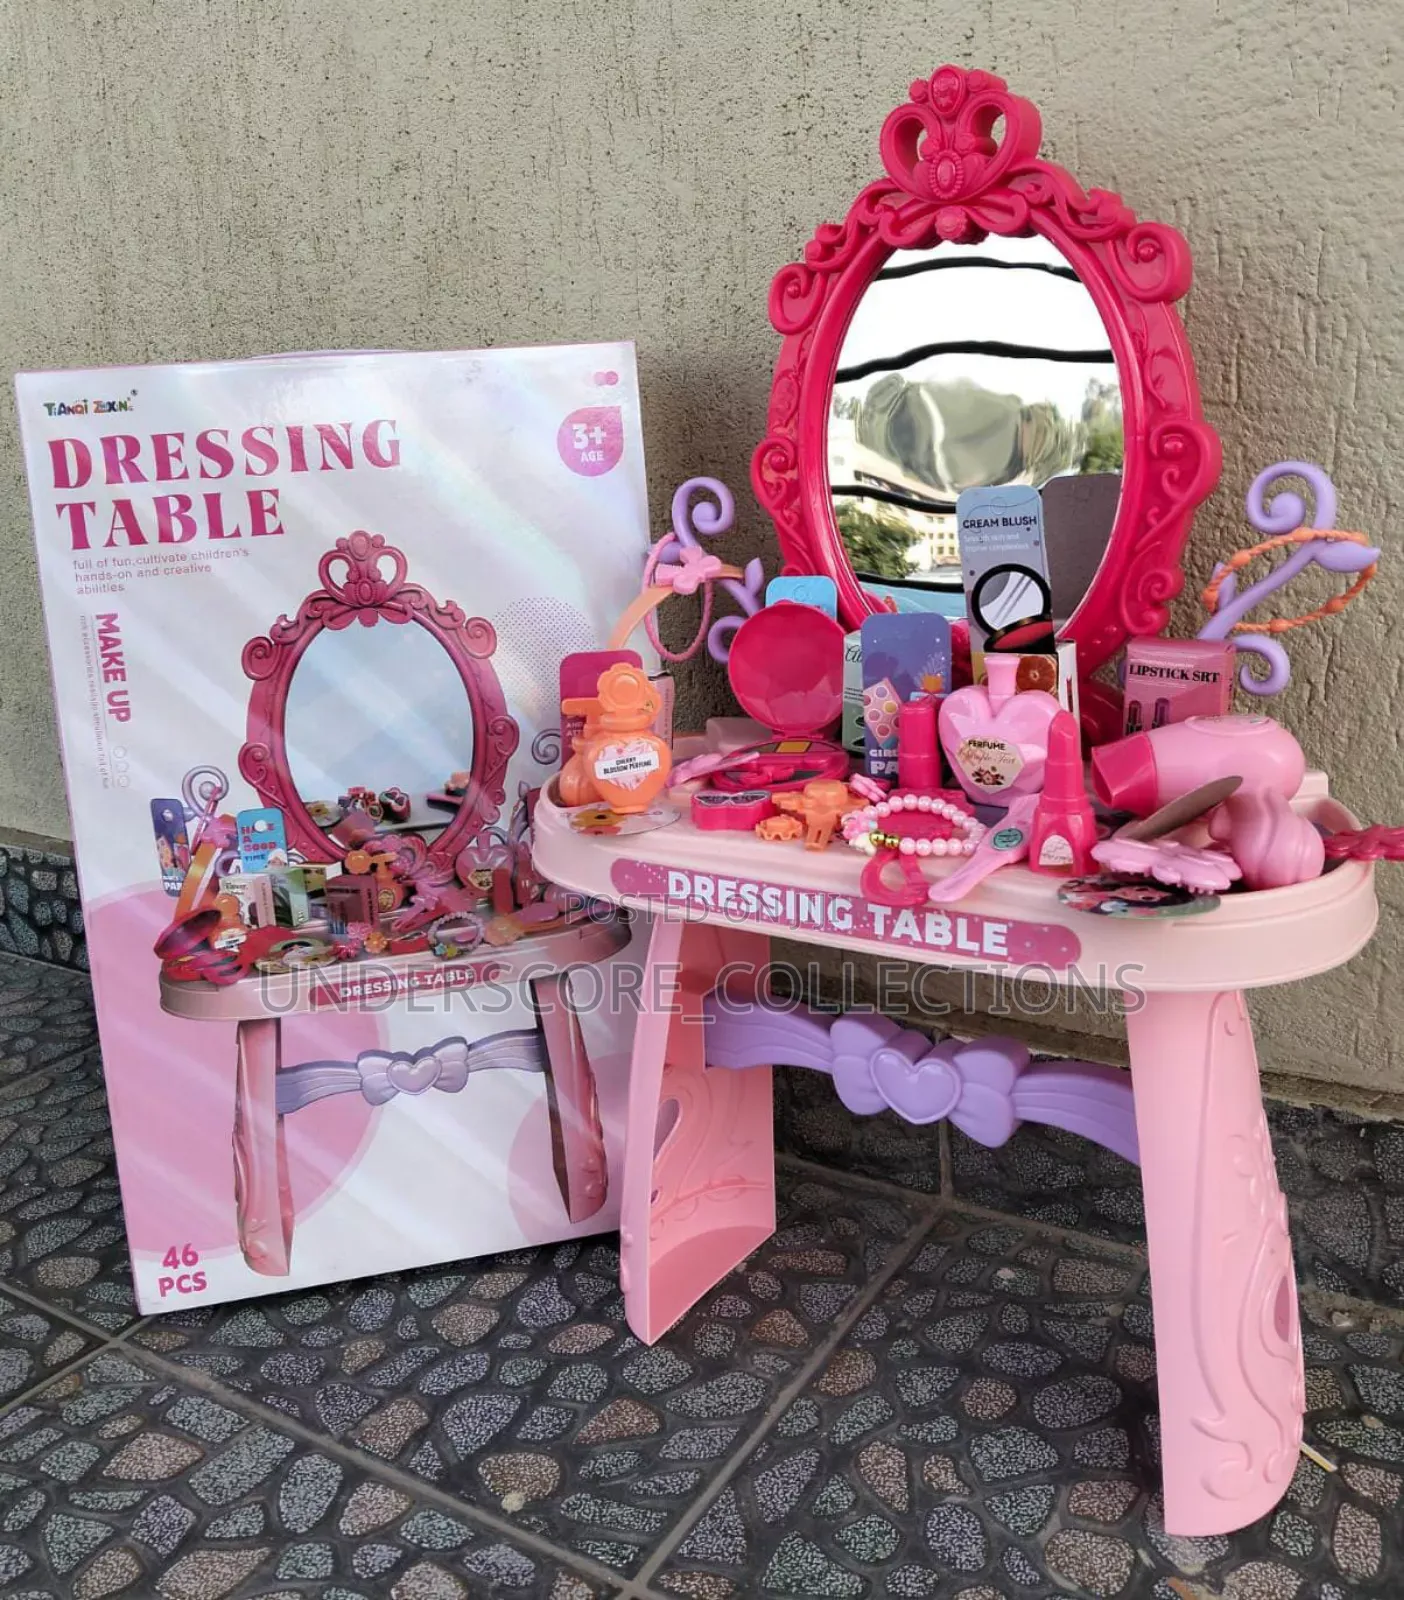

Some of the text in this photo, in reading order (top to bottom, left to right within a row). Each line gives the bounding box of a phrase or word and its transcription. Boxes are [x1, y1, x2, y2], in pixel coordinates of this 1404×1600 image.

[572, 422, 607, 450] 3+
[47, 420, 401, 489] DRESSING
[580, 450, 605, 463] AGE
[55, 489, 285, 550] TABLE
[962, 515, 1037, 529] CREAM BLUSH
[73, 559, 93, 570] full
[97, 558, 108, 569] of
[191, 547, 249, 561] children's
[75, 563, 212, 583] hands-on and creative
[77, 583, 125, 596] abilities
[96, 612, 131, 722] MAKE UP
[1129, 664, 1220, 683] LIPSTICK SRT
[666, 870, 1009, 956] DRESSING TABLE
[340, 968, 474, 998] DRESSING TABLE
[163, 1243, 199, 1269] 46
[158, 1271, 207, 1298] PCS
